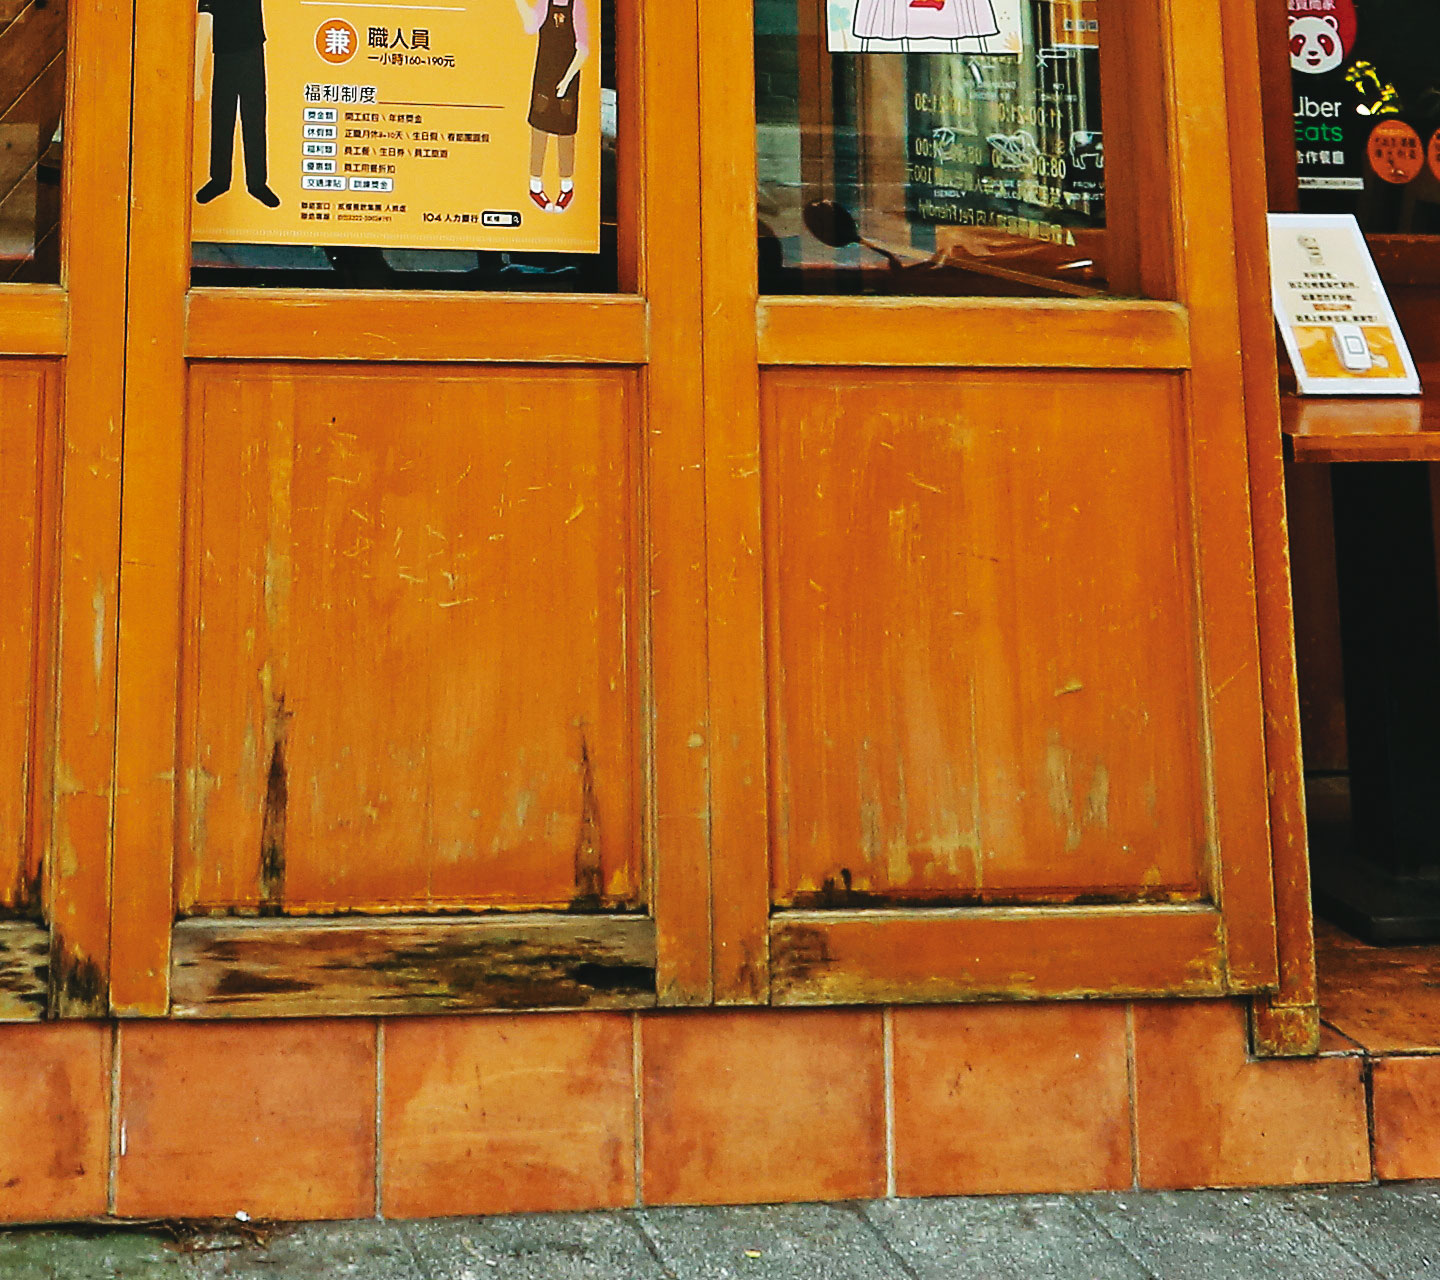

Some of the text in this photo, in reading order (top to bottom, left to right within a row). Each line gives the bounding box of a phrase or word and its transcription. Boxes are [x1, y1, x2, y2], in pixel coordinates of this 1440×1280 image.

[324, 27, 350, 55] 兼
[368, 27, 431, 51] 職人員
[304, 83, 377, 104] 福利制度
